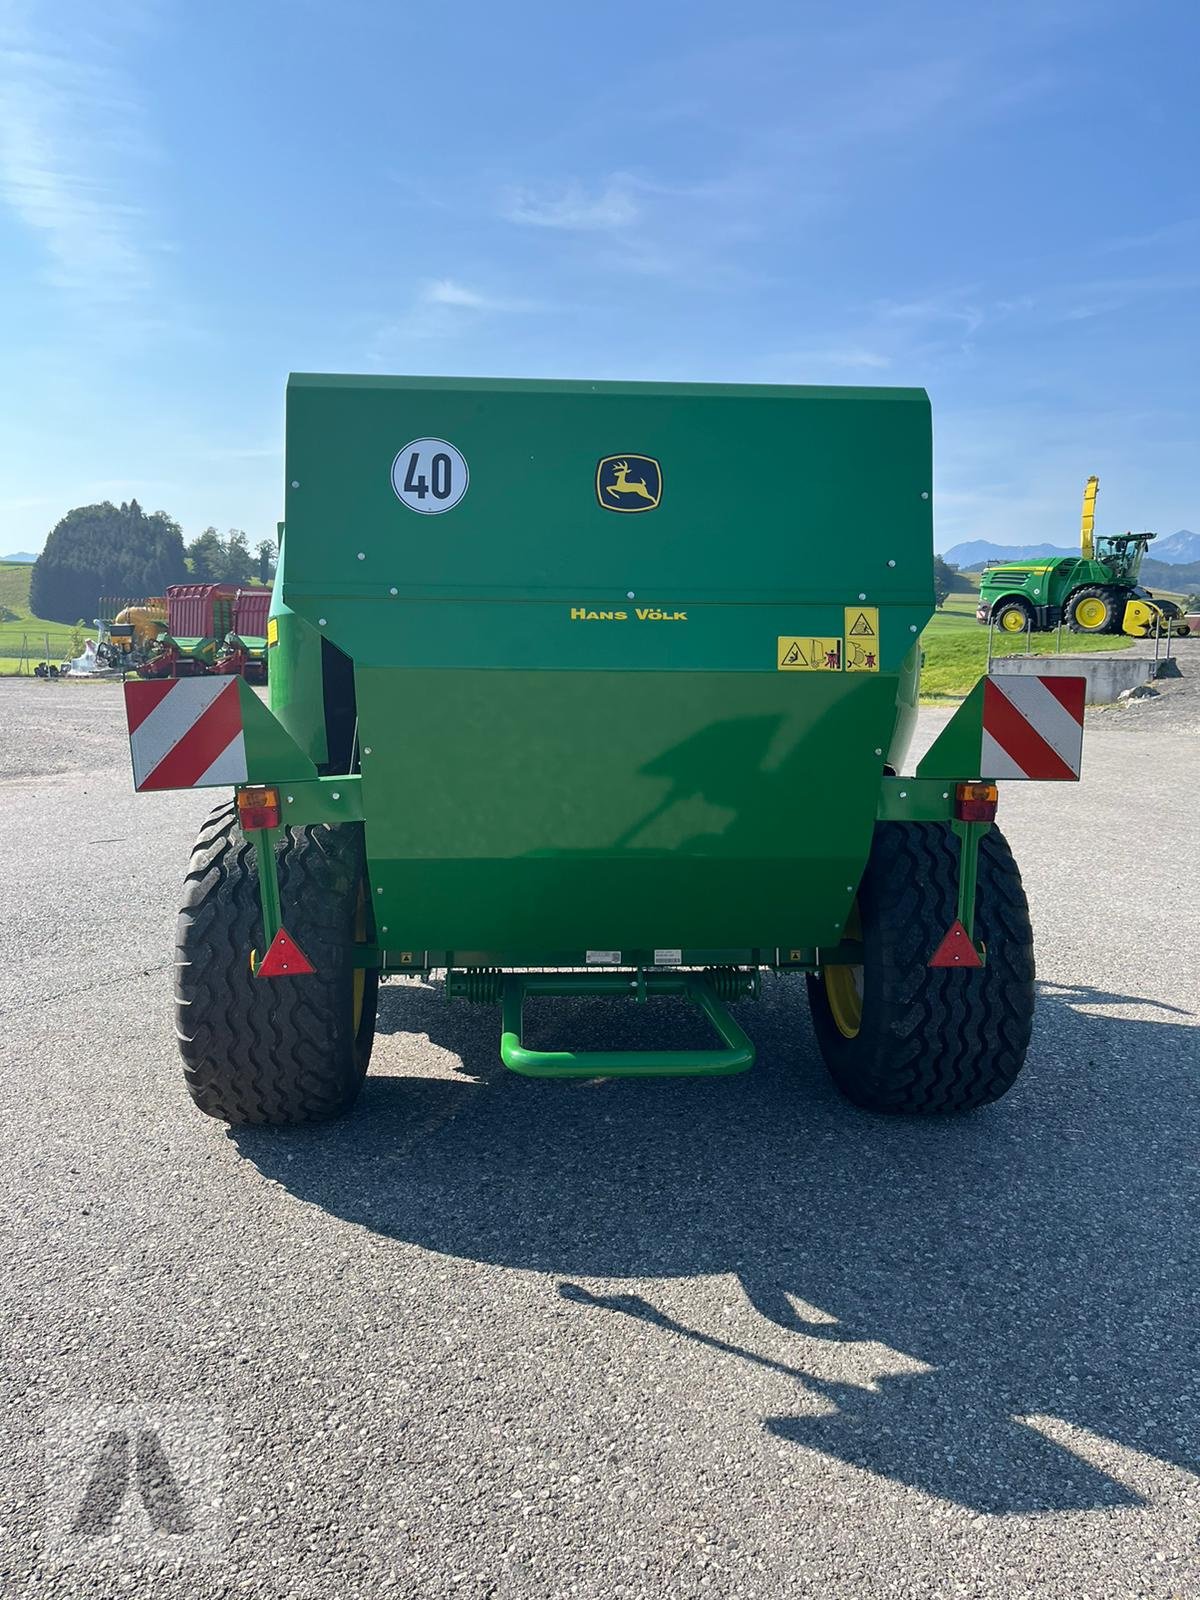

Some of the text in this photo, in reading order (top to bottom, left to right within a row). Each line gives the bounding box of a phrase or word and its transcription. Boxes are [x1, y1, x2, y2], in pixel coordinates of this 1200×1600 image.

[404, 452, 452, 499] 40
[570, 608, 688, 620] HANS VÖLK
